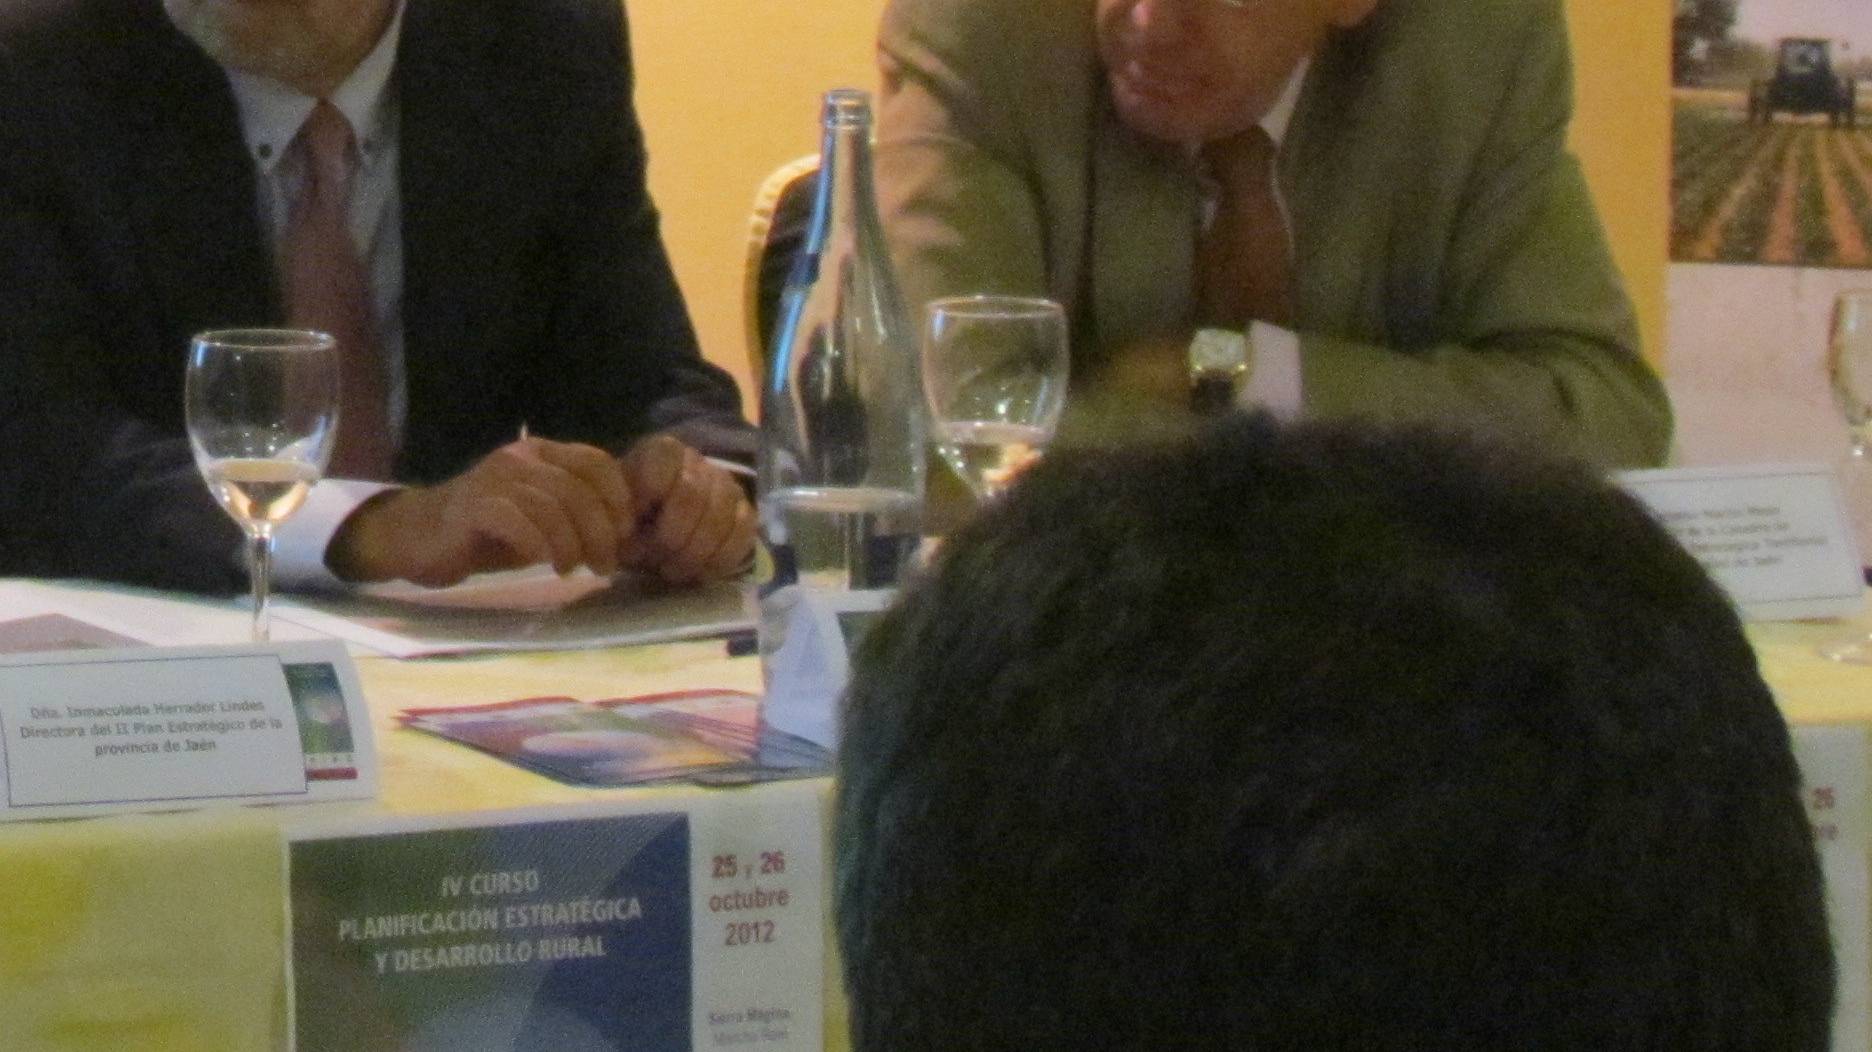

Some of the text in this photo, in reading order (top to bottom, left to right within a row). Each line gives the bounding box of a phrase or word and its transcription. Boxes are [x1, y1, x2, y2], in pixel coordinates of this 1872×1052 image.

[20, 725, 85, 739] Directora
[90, 723, 111, 735] del
[114, 721, 129, 734] II
[133, 720, 163, 733] Plan
[249, 717, 266, 729] de
[269, 716, 282, 728] la
[95, 737, 216, 756] provincia de Jaén
[711, 853, 737, 879] 25
[760, 850, 785, 875] 26
[441, 870, 539, 896] IV CURSO
[709, 887, 790, 913] octubre
[339, 896, 642, 941] PLANIFICACIÓN ESTRATÉGICA
[725, 919, 776, 946] 2012
[375, 935, 607, 974] Y DESARROLLO RURAL
